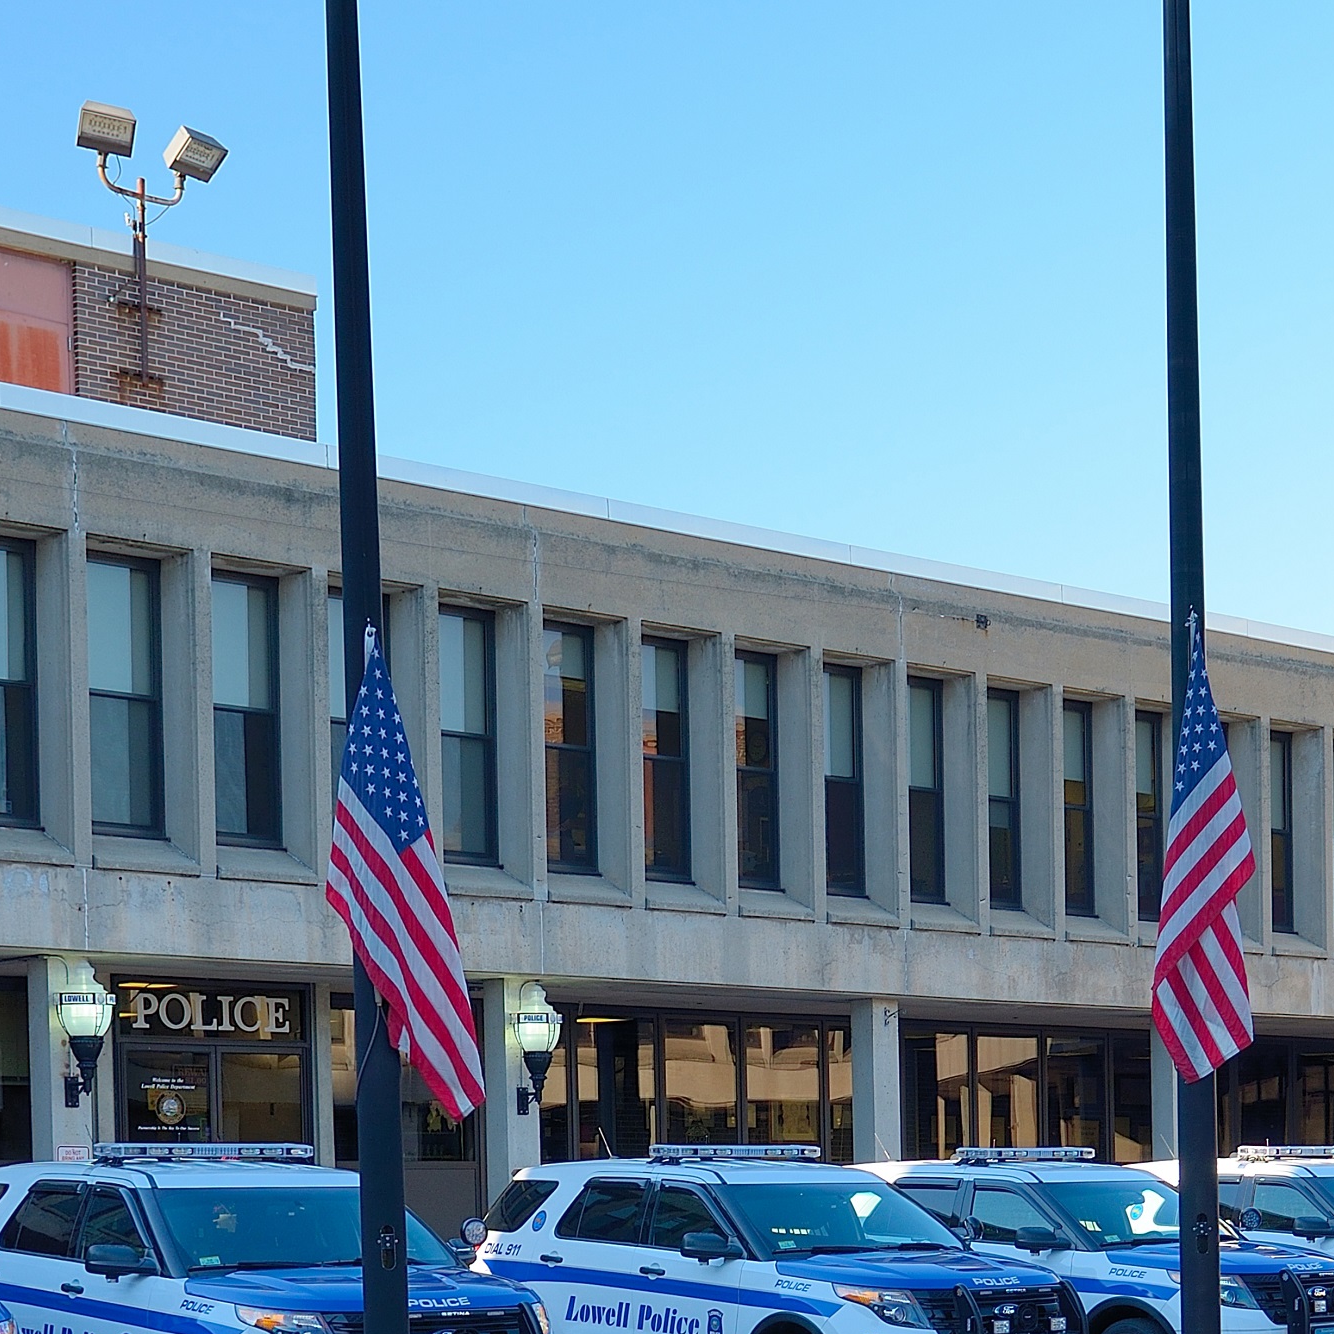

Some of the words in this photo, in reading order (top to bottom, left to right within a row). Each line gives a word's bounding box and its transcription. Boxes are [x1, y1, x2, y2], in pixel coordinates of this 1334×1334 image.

[132, 992, 290, 1033] POLICE
[484, 1242, 504, 1255] DIAL
[505, 1243, 522, 1256] 911
[1108, 1267, 1147, 1279] POLICE
[1287, 1262, 1323, 1271] POLICE
[775, 1279, 812, 1292] POLICE
[972, 1276, 1020, 1286] POLICE
[180, 1299, 215, 1315] POLICE
[408, 1296, 470, 1308] POLICE
[565, 1296, 630, 1328] Lowell
